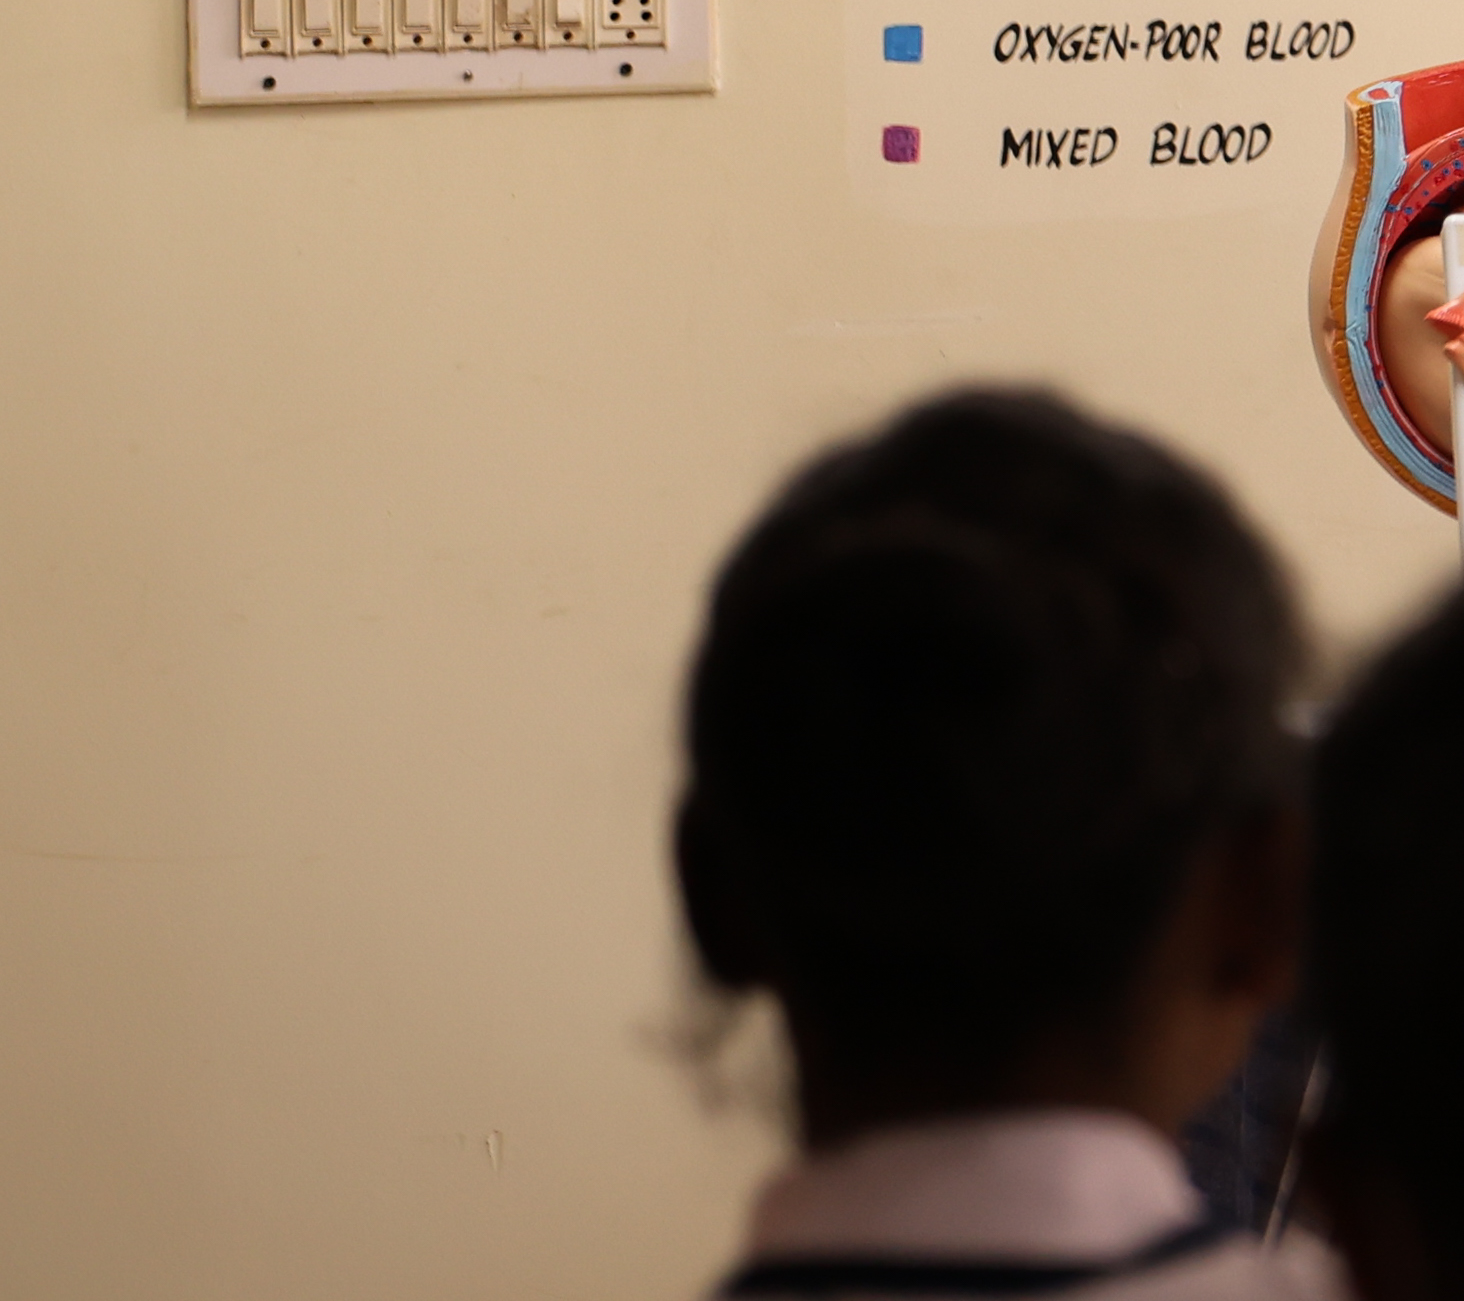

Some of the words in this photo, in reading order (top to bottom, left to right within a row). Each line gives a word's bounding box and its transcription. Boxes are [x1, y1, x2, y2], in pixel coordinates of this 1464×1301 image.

[993, 19, 1222, 64] OXYGEN-POOR
[1245, 20, 1355, 62] BLOOD
[1000, 126, 1118, 169] MIXED
[1149, 122, 1272, 166] BLOOD
